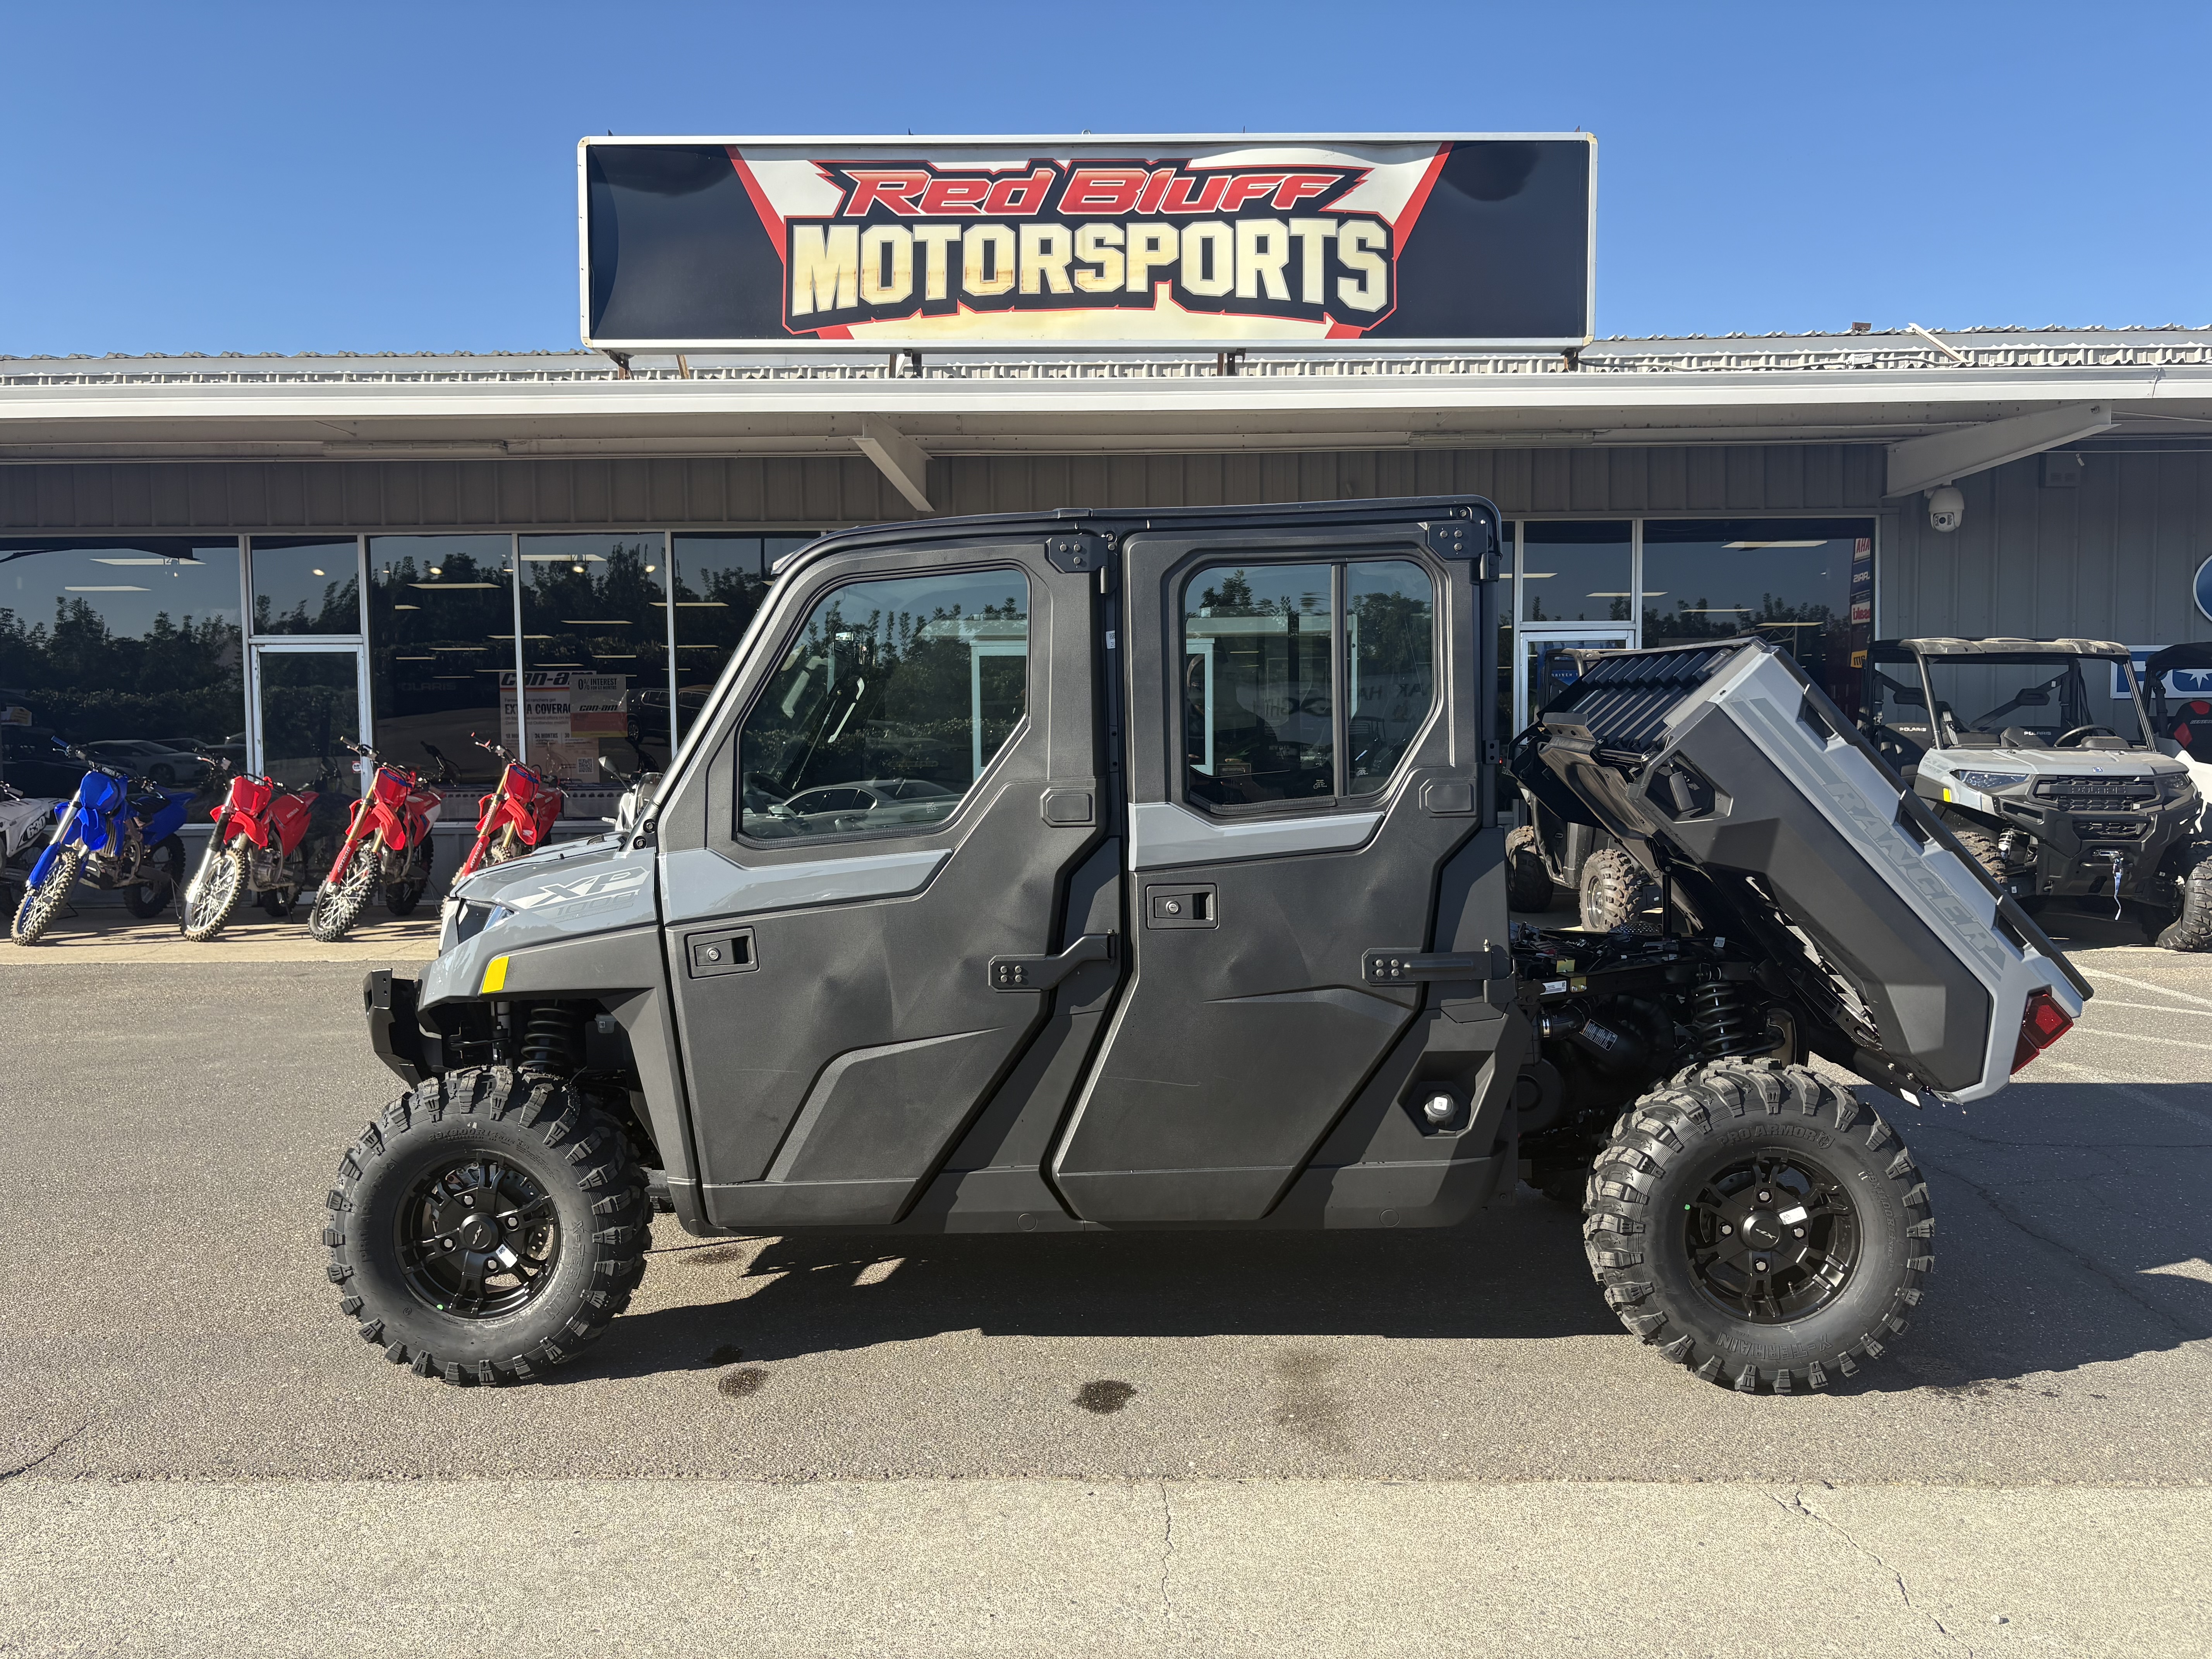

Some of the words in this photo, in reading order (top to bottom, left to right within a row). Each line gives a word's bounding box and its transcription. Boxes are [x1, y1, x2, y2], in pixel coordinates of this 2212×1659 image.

[844, 168, 1058, 217] Red
[792, 218, 1388, 315] MOTORSPORTS
[578, 678, 590, 690] 0%
[1822, 781, 1999, 951] RANGER
[527, 867, 649, 909] XP
[556, 891, 637, 916] 1000
[1717, 1128, 1751, 1146] PRO
[1754, 1124, 1817, 1141] ARMOR
[543, 1220, 585, 1320] X-TERRAIN
[1716, 1332, 1833, 1360] X-TERRAIN
